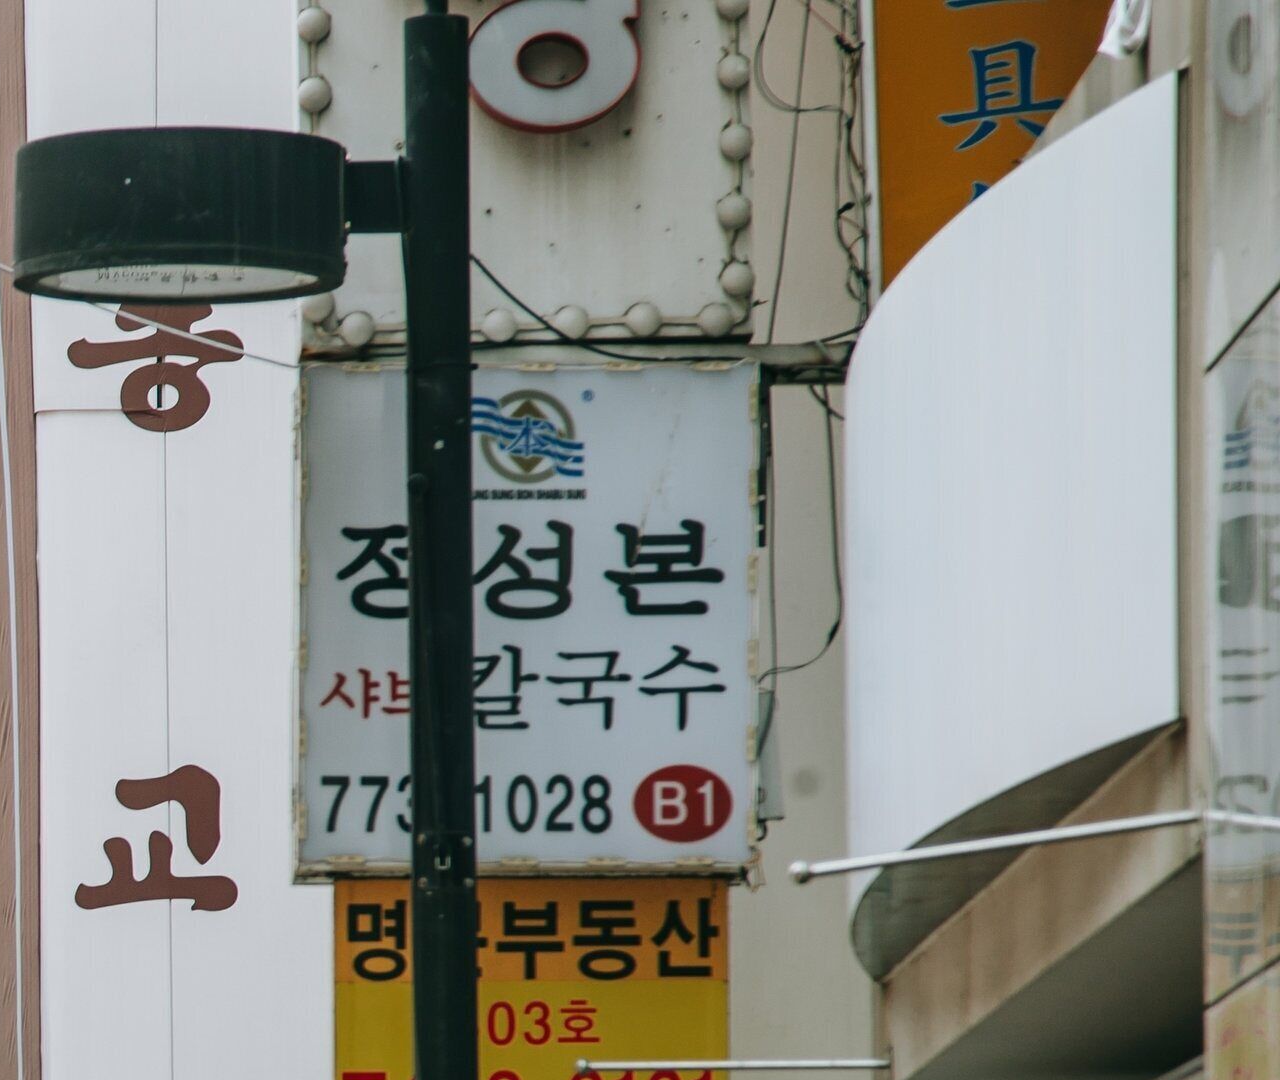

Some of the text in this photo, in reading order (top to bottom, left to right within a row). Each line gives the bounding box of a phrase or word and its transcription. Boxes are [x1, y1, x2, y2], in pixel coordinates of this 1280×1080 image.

[336, 520, 725, 619] 정성본
[473, 644, 727, 731] 칼국수
[320, 774, 613, 834] 7731028
[652, 780, 715, 827] B1
[347, 898, 720, 981] 명부동산
[486, 999, 601, 1046] 03호
